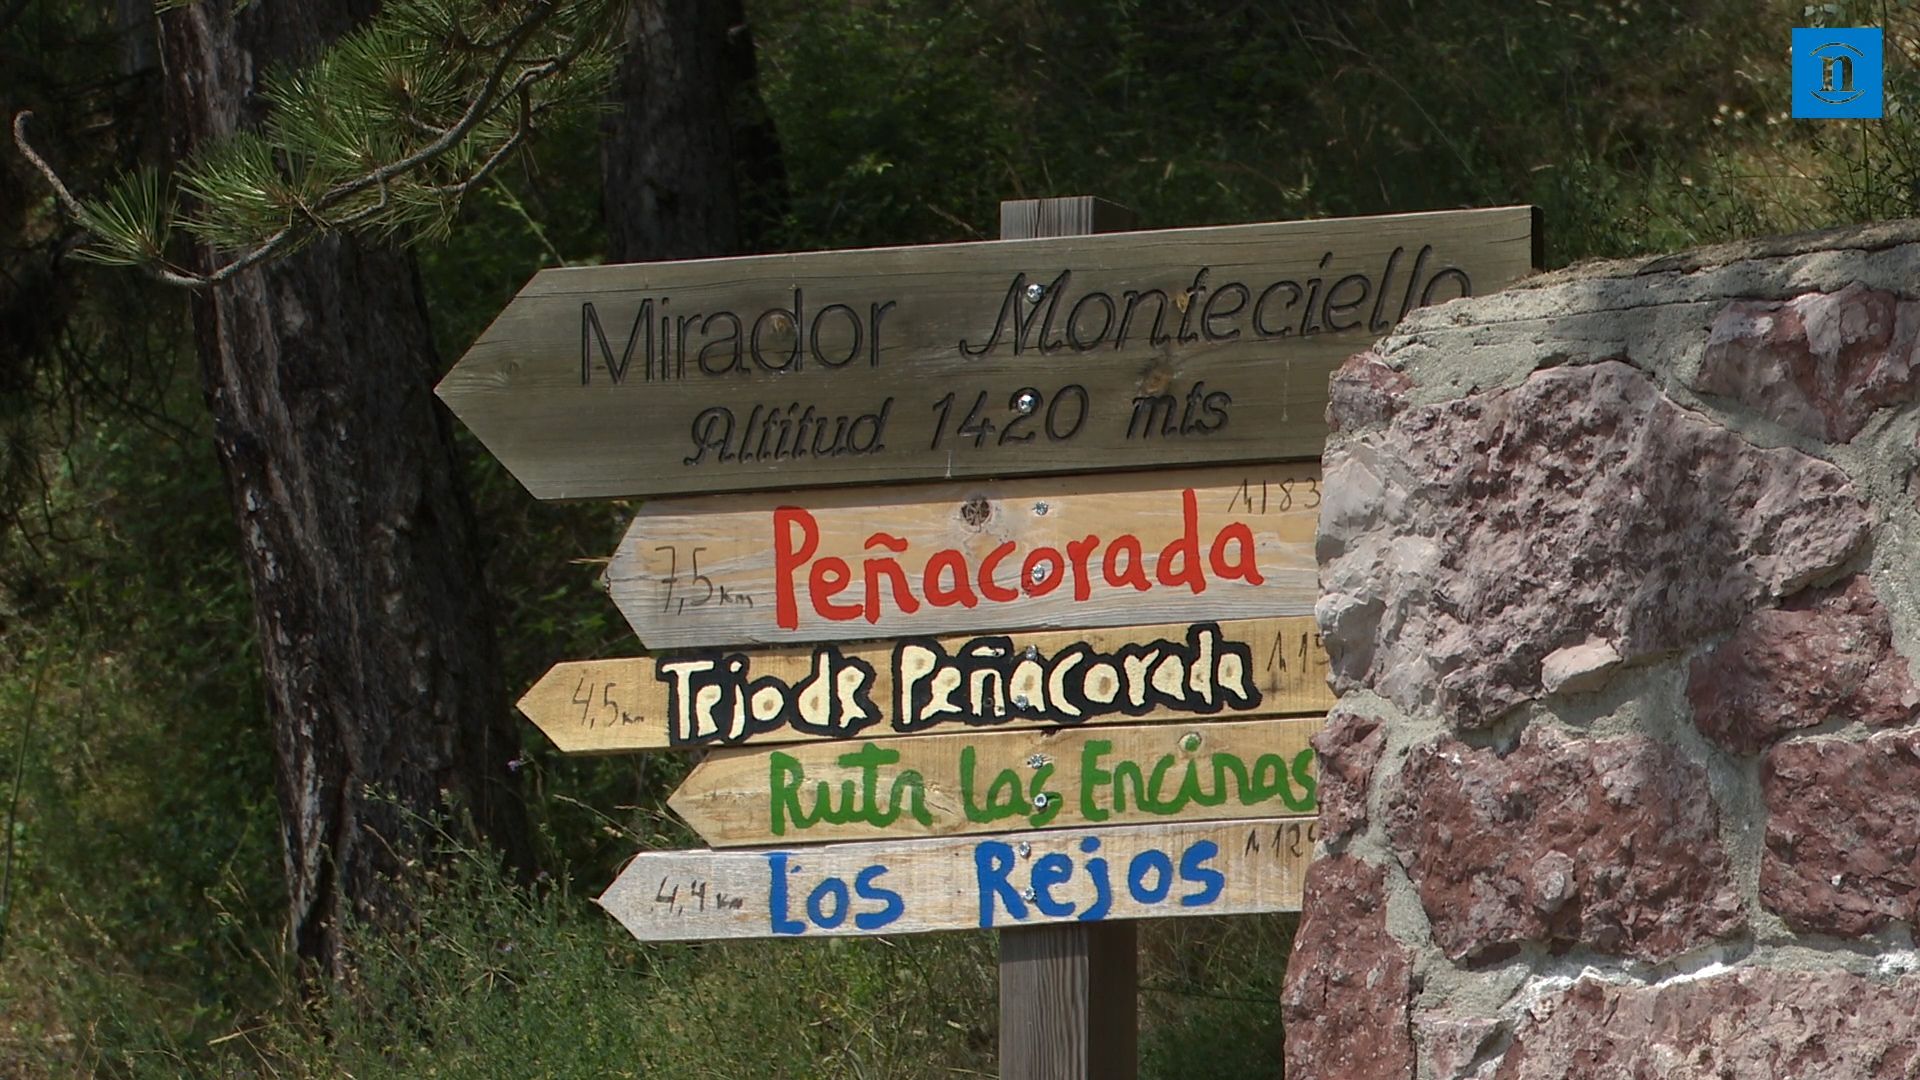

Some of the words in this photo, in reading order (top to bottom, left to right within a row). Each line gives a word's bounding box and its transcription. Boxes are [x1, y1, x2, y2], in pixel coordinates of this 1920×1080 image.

[581, 288, 897, 387] Mirador
[958, 245, 1472, 359] Monteciello
[682, 397, 894, 466] Altitud
[930, 383, 1089, 451] 1420
[1126, 382, 1232, 440] mts
[655, 545, 714, 616] 7,5
[774, 487, 1265, 631] Peñacorada
[572, 677, 619, 730] 4,5
[895, 626, 1256, 728] Peñacorada
[770, 743, 933, 835] Ruta
[1080, 733, 1318, 822] Encinas
[655, 875, 707, 917] 4,4
[768, 851, 905, 934] Los
[974, 836, 1225, 929] Rejos
